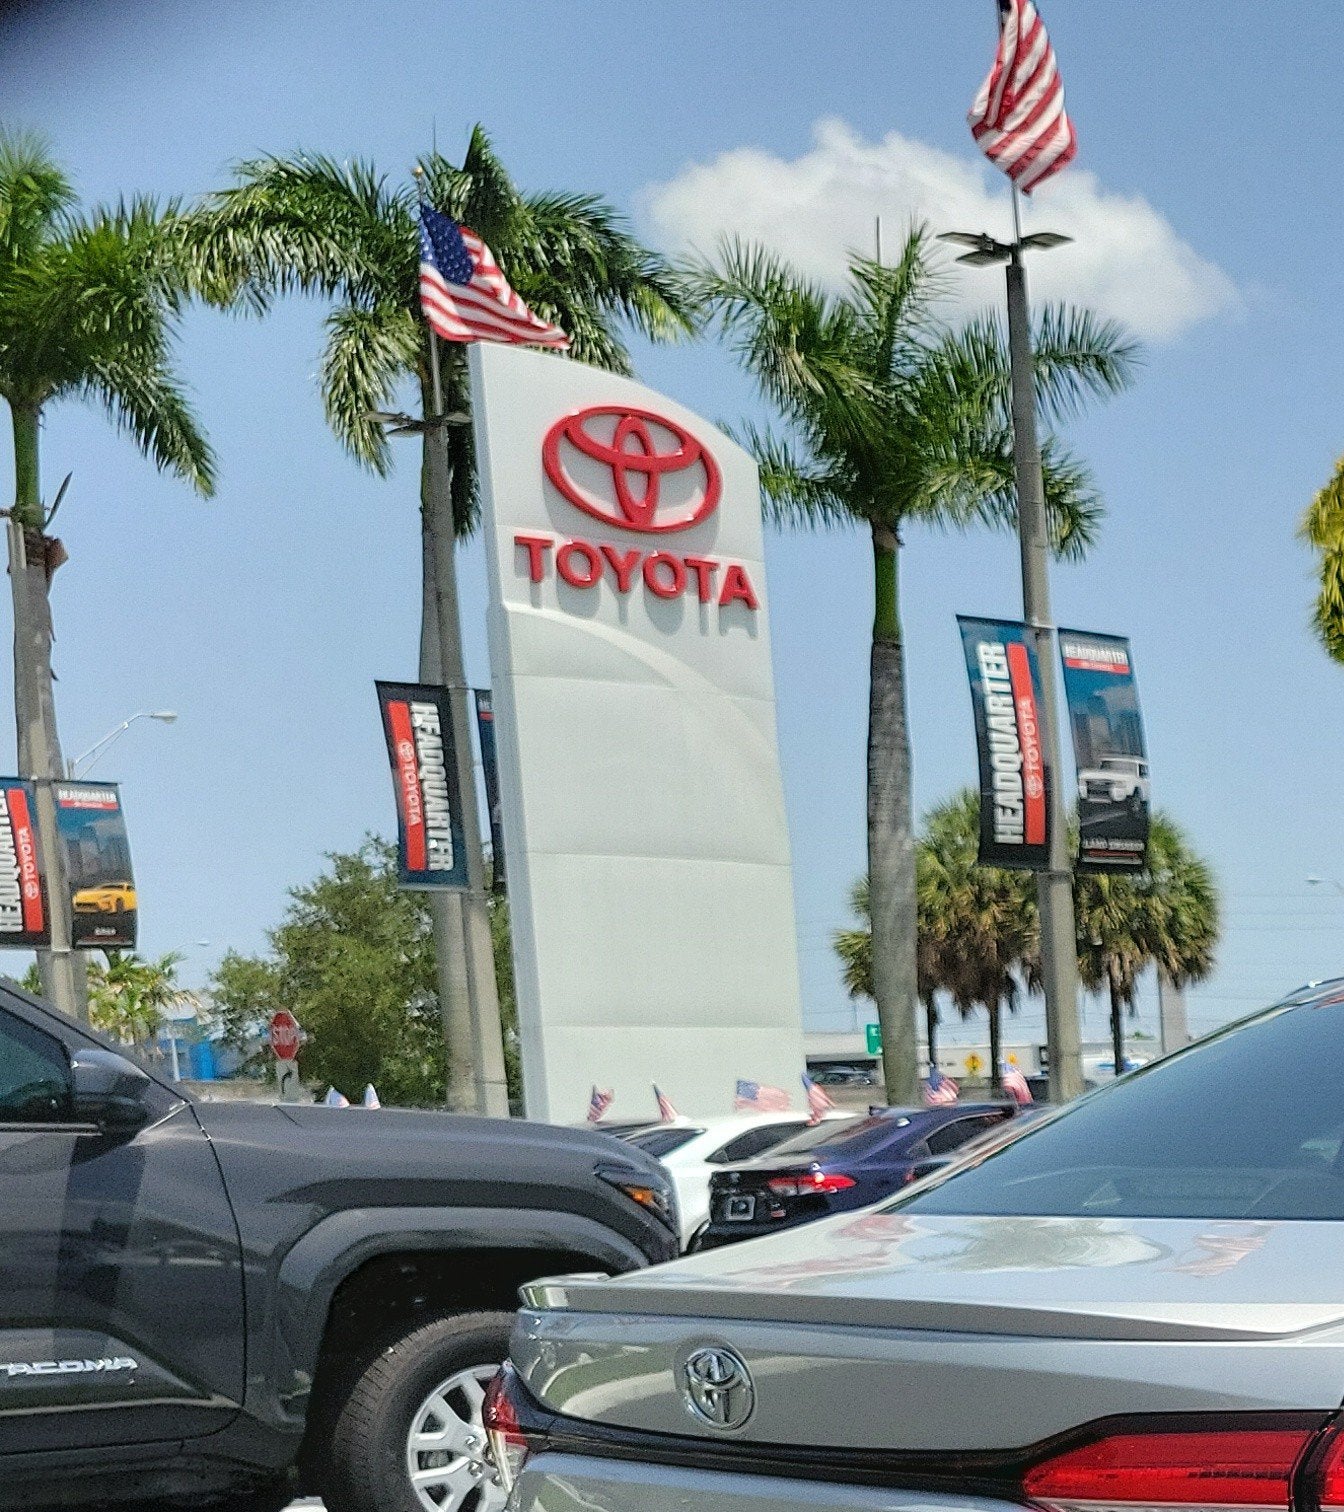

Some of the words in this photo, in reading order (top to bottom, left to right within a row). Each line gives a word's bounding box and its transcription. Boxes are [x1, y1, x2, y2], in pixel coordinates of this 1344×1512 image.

[514, 535, 759, 610] TOYOTA
[977, 641, 1024, 844] HEADQUARTER
[1019, 699, 1041, 773] TOYOTA
[405, 762, 422, 826] TOYOTA
[410, 701, 454, 871] HEADQUARTER
[18, 827, 36, 880] TOYOTA
[0, 1357, 138, 1376] ACOMA
